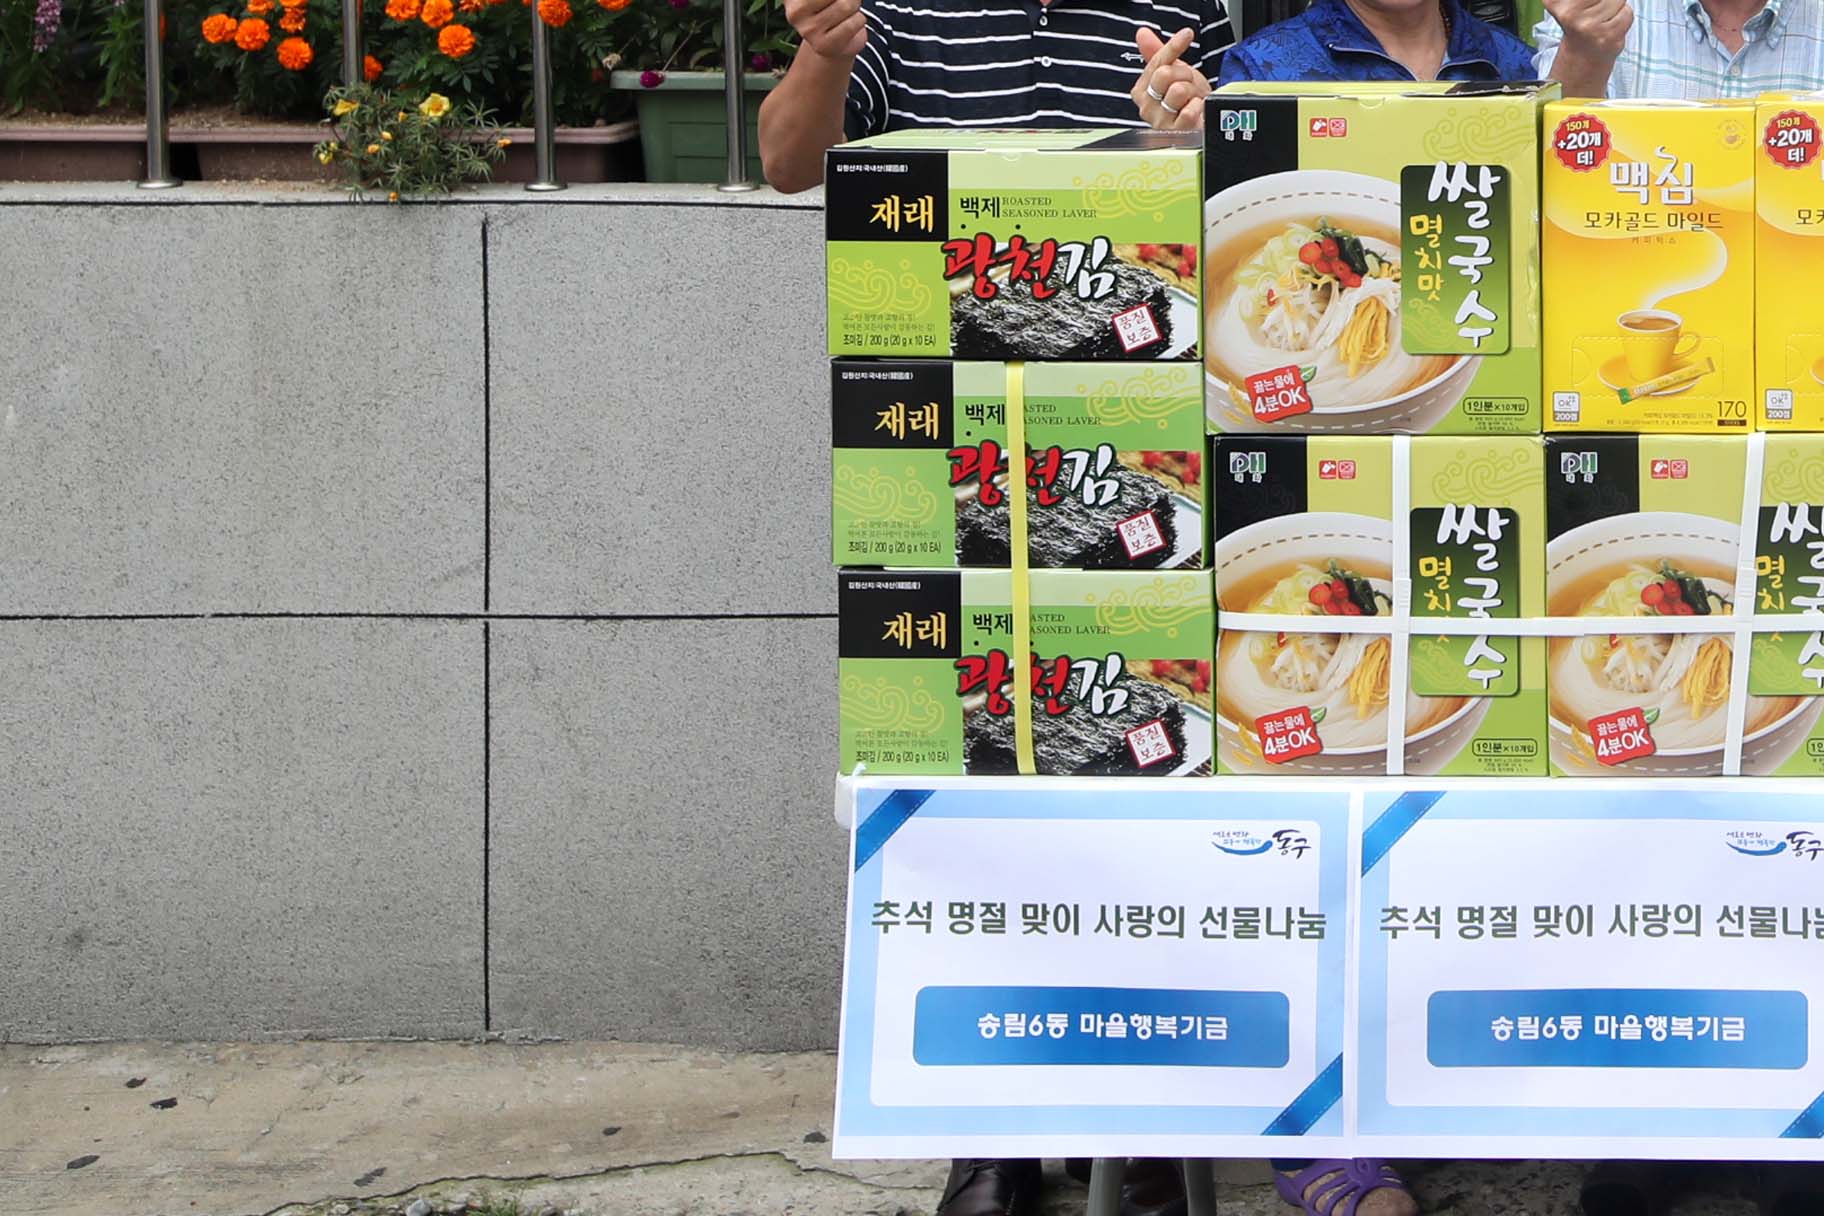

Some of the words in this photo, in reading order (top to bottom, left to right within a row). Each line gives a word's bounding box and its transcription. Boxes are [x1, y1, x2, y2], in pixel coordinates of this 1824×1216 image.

[1566, 120, 1590, 131] 150개
[1777, 117, 1800, 128] 150개
[1557, 131, 1601, 150] +20개
[1768, 128, 1812, 147] +20개
[1577, 150, 1593, 165] 더!
[1788, 147, 1804, 162] 더!
[1610, 145, 1694, 205] 맥심
[960, 196, 1000, 219] 백제
[1002, 197, 1052, 206] ROASTED
[1002, 209, 1058, 218] SEASONED
[1063, 209, 1097, 218] LAVER
[869, 195, 935, 233] 재래
[1584, 211, 1661, 231] 모카골드
[1667, 211, 1724, 231] 마일드
[941, 232, 1117, 300] 광천김
[1409, 214, 1445, 301] 멸치맛
[1427, 160, 1501, 349] 쌀국수
[1118, 311, 1146, 329] 품질
[1254, 387, 1306, 414] 4분OK
[1717, 400, 1747, 418] 170
[874, 402, 939, 440] 재래
[965, 404, 1005, 426] 백제
[1067, 416, 1102, 425] LAVER
[881, 612, 947, 650] 재래
[973, 614, 1012, 636] 백제
[1076, 626, 1111, 634] LAVER
[1264, 729, 1316, 755] 4분OK
[1596, 730, 1649, 756] 4분OK
[1272, 829, 1312, 860] 동구
[1787, 831, 1824, 862] 동구
[871, 900, 933, 935] 추석
[947, 901, 1007, 935] 명절
[1021, 902, 1081, 936] 맞이
[1094, 904, 1185, 938] 사랑의
[1199, 906, 1327, 939] 선물나눔
[1380, 905, 1442, 940] 추석
[1456, 906, 1518, 939] 명절
[1532, 904, 1594, 938] 맞이
[1607, 903, 1702, 938] 사랑의
[977, 1012, 1069, 1039] 송림6동
[1080, 1012, 1228, 1041] 마을행복기금
[1490, 1015, 1583, 1042] 송림6동
[1594, 1014, 1745, 1042] 마을행복기금
